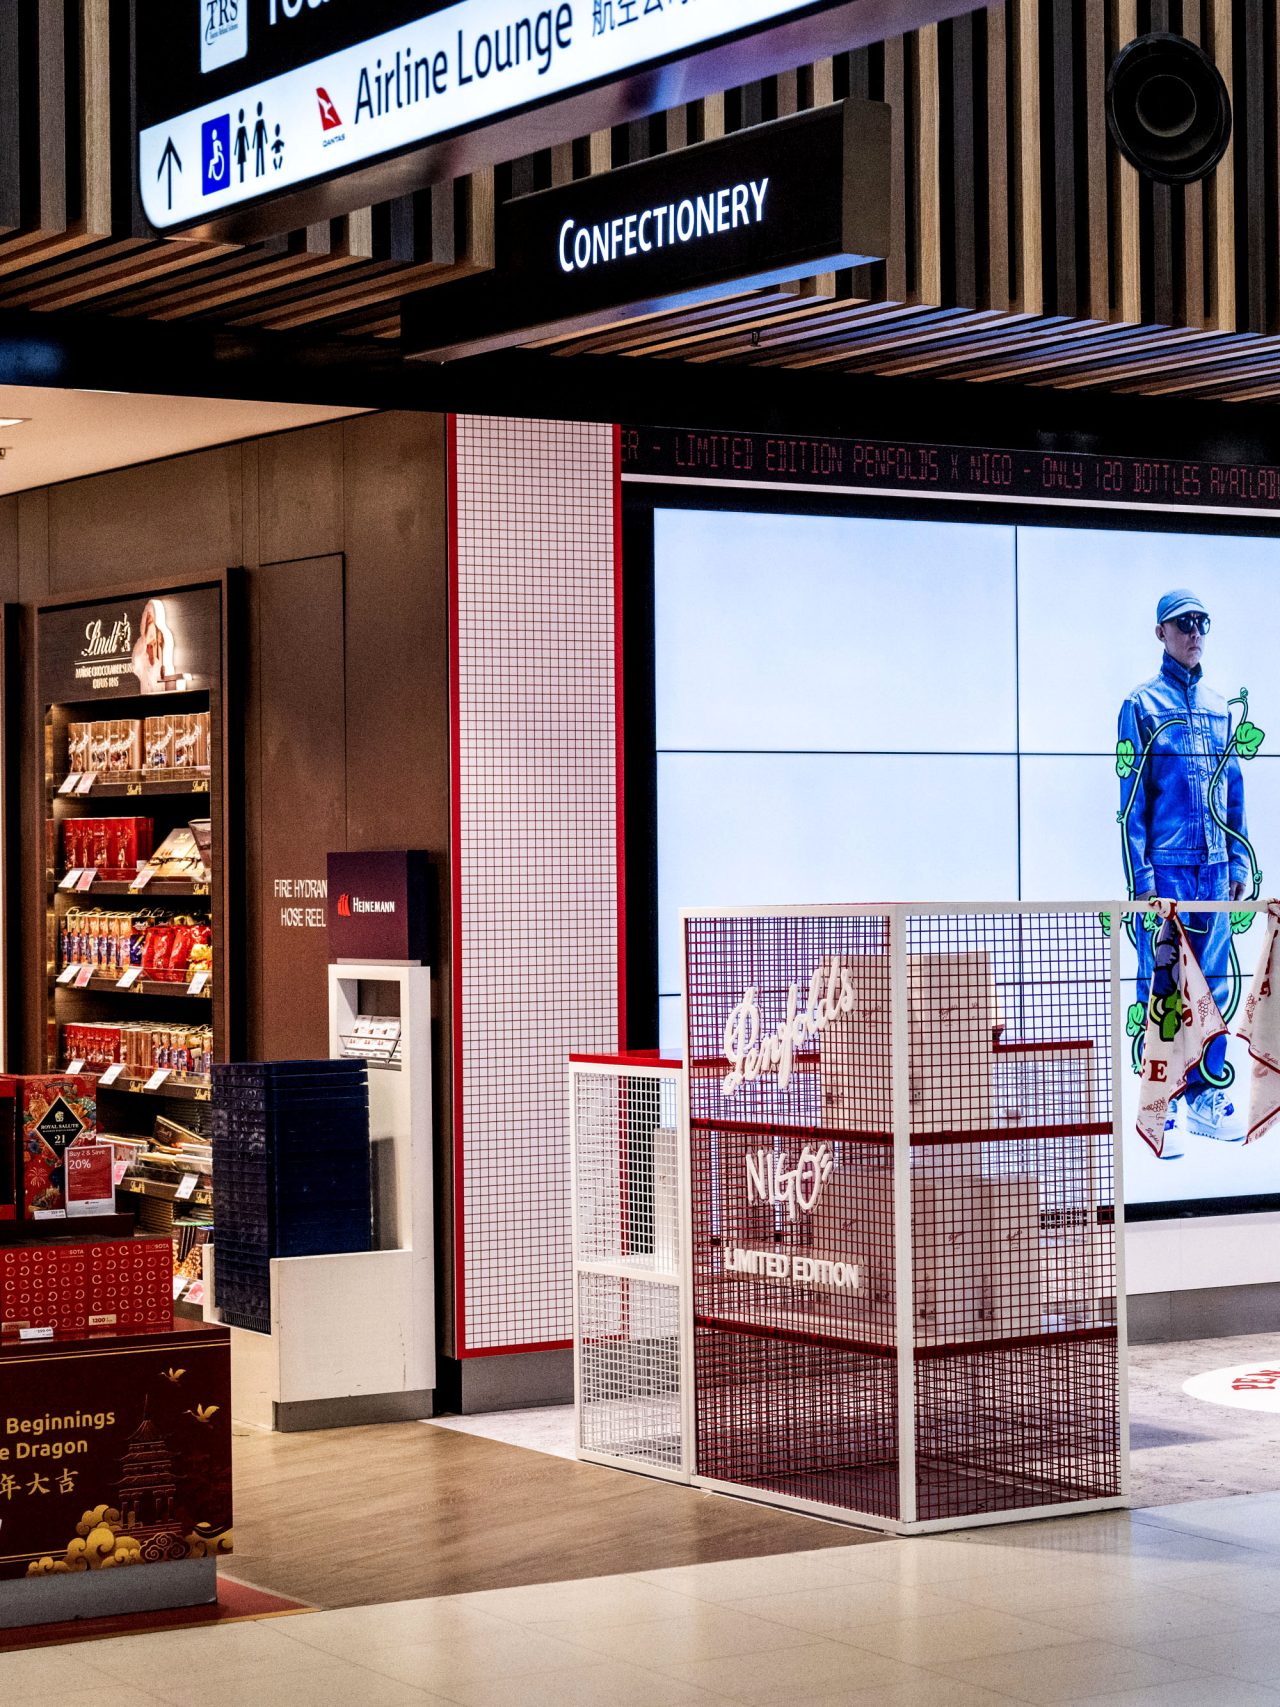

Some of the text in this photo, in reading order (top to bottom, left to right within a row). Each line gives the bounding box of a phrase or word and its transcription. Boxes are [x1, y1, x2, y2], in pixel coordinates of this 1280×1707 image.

[354, 48, 448, 125] Airline
[457, 3, 573, 86] Lounge
[559, 177, 769, 273] CONFECTIONERY
[675, 434, 753, 469] LIMITED
[766, 440, 842, 474] EDITION
[853, 446, 939, 480] PENFOLDS
[950, 453, 959, 480] X
[970, 454, 1012, 485] NIGO
[1042, 457, 1083, 489] ONLY
[1096, 461, 1123, 491] 120
[1133, 463, 1200, 495] BOTTLES
[81, 619, 121, 656] Lindt
[274, 879, 292, 898] FIRE
[353, 897, 395, 913] HEINEMANN
[281, 907, 327, 928] HOSE REEL
[723, 955, 855, 1096] Penfolds
[54, 1134, 65, 1144] 21
[69, 1151, 81, 1160] Buy
[69, 1158, 92, 1170] 20%
[724, 1246, 860, 1289] LIMITED EDITION
[6, 1410, 116, 1436] Beginnings
[16, 1440, 88, 1459] Dragon
